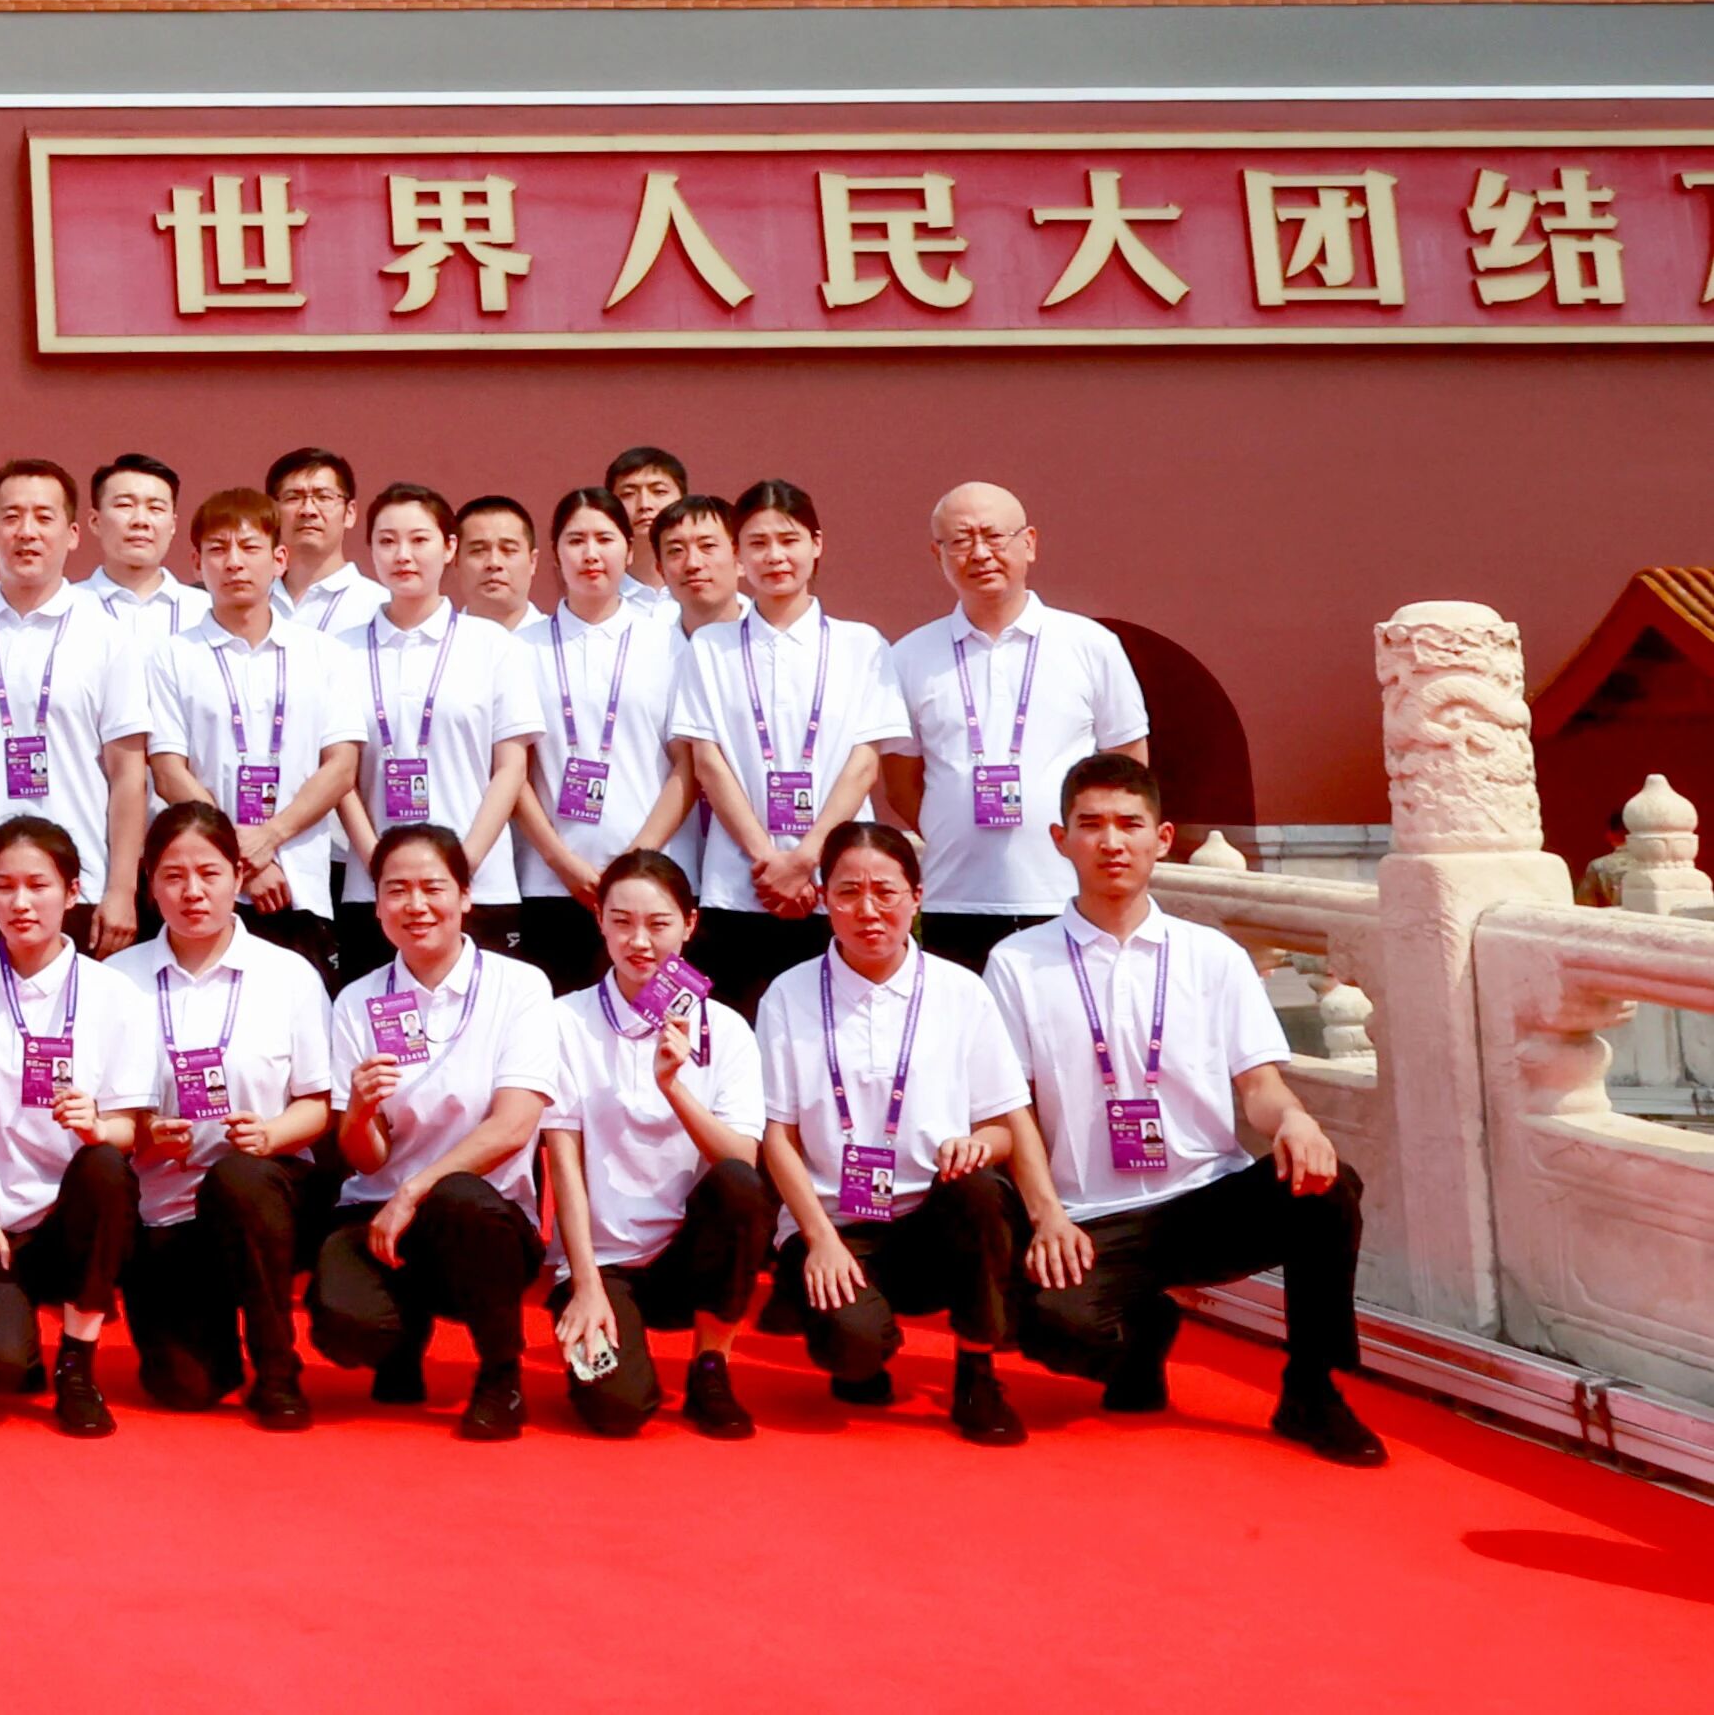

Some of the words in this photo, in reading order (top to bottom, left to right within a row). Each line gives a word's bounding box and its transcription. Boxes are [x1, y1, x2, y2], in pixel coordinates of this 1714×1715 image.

[155, 168, 1714, 314] 世界人民大团结
